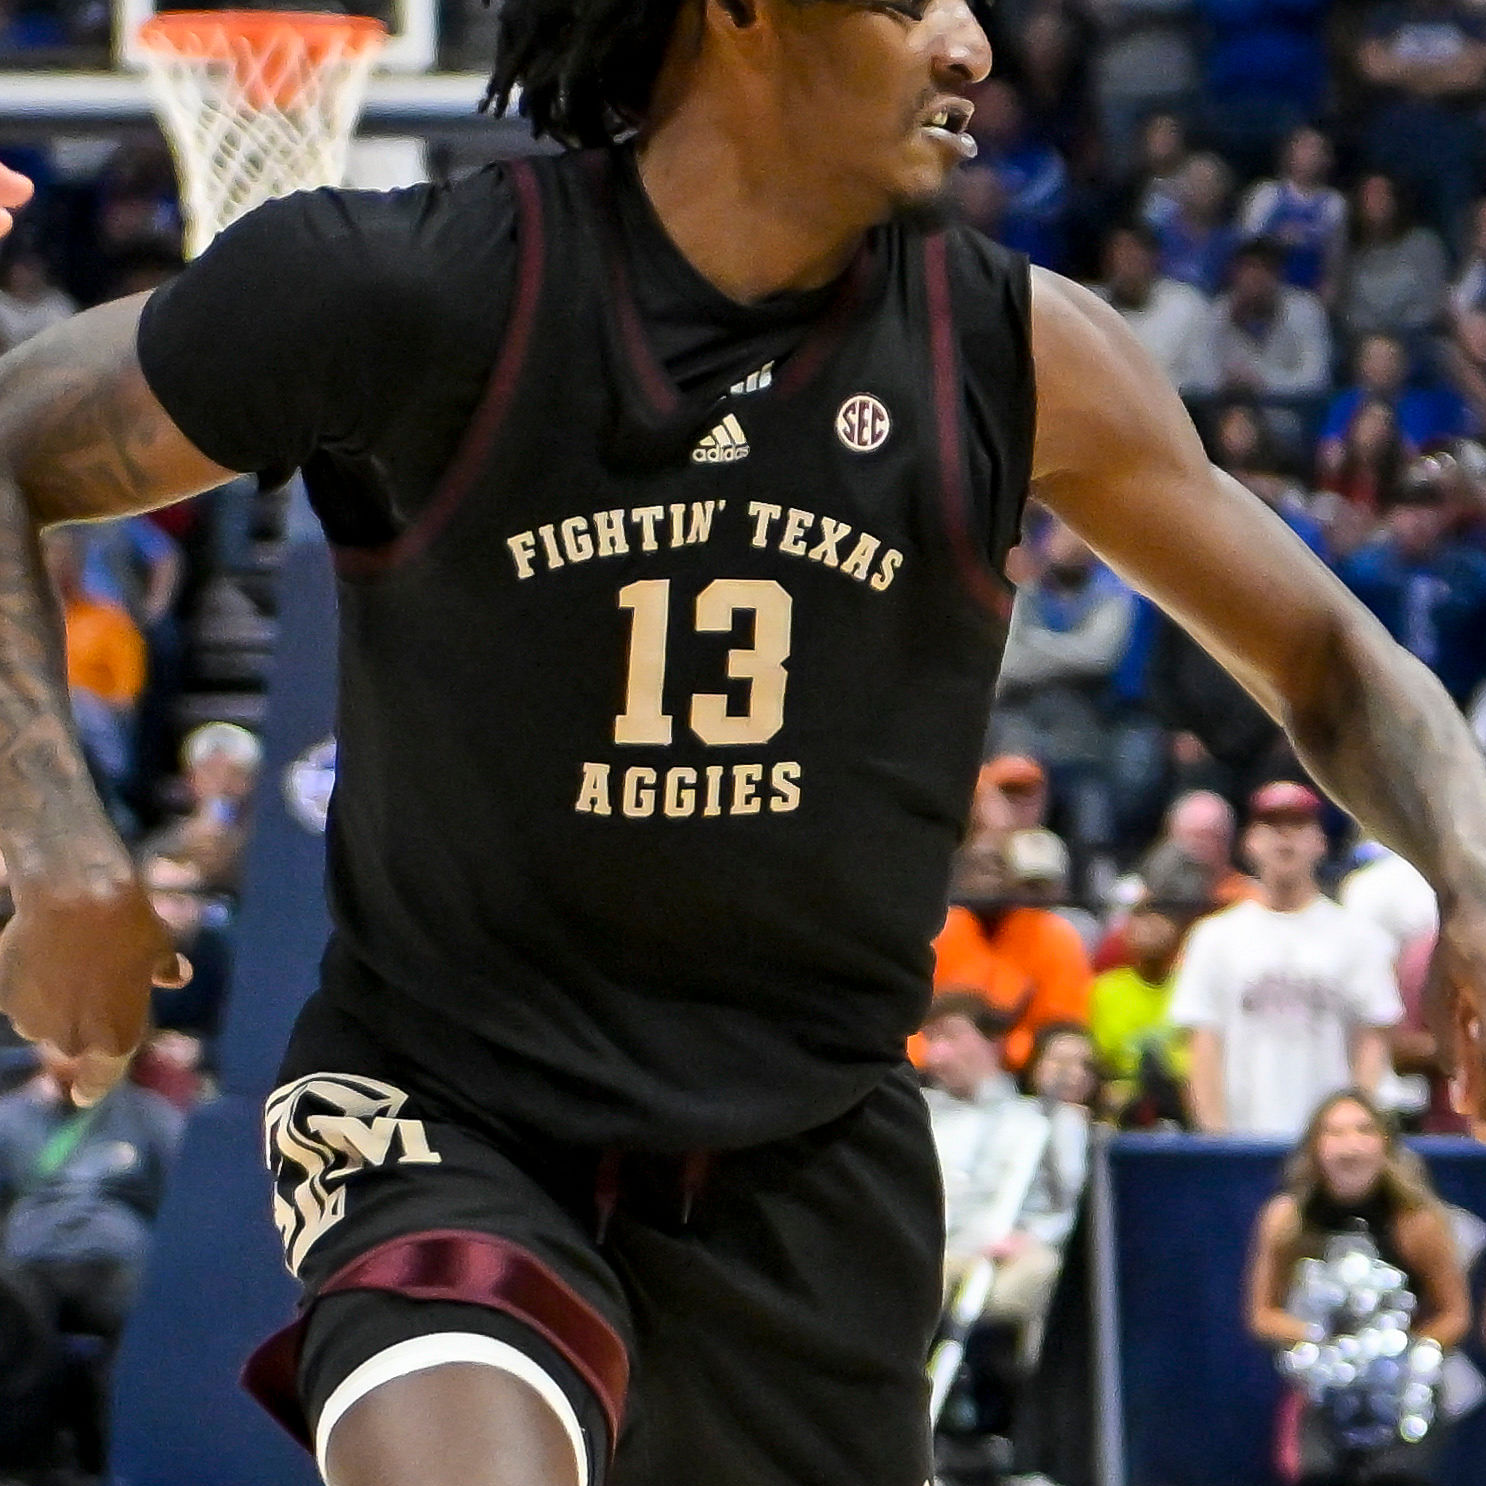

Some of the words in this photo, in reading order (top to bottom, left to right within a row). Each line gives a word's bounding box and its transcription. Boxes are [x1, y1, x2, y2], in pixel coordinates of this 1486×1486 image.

[841, 398, 887, 447] SEC
[506, 499, 727, 580] FIGHTIN'
[747, 500, 903, 592] TEXAS
[614, 578, 793, 745] 13
[575, 761, 802, 818] AGGIES
